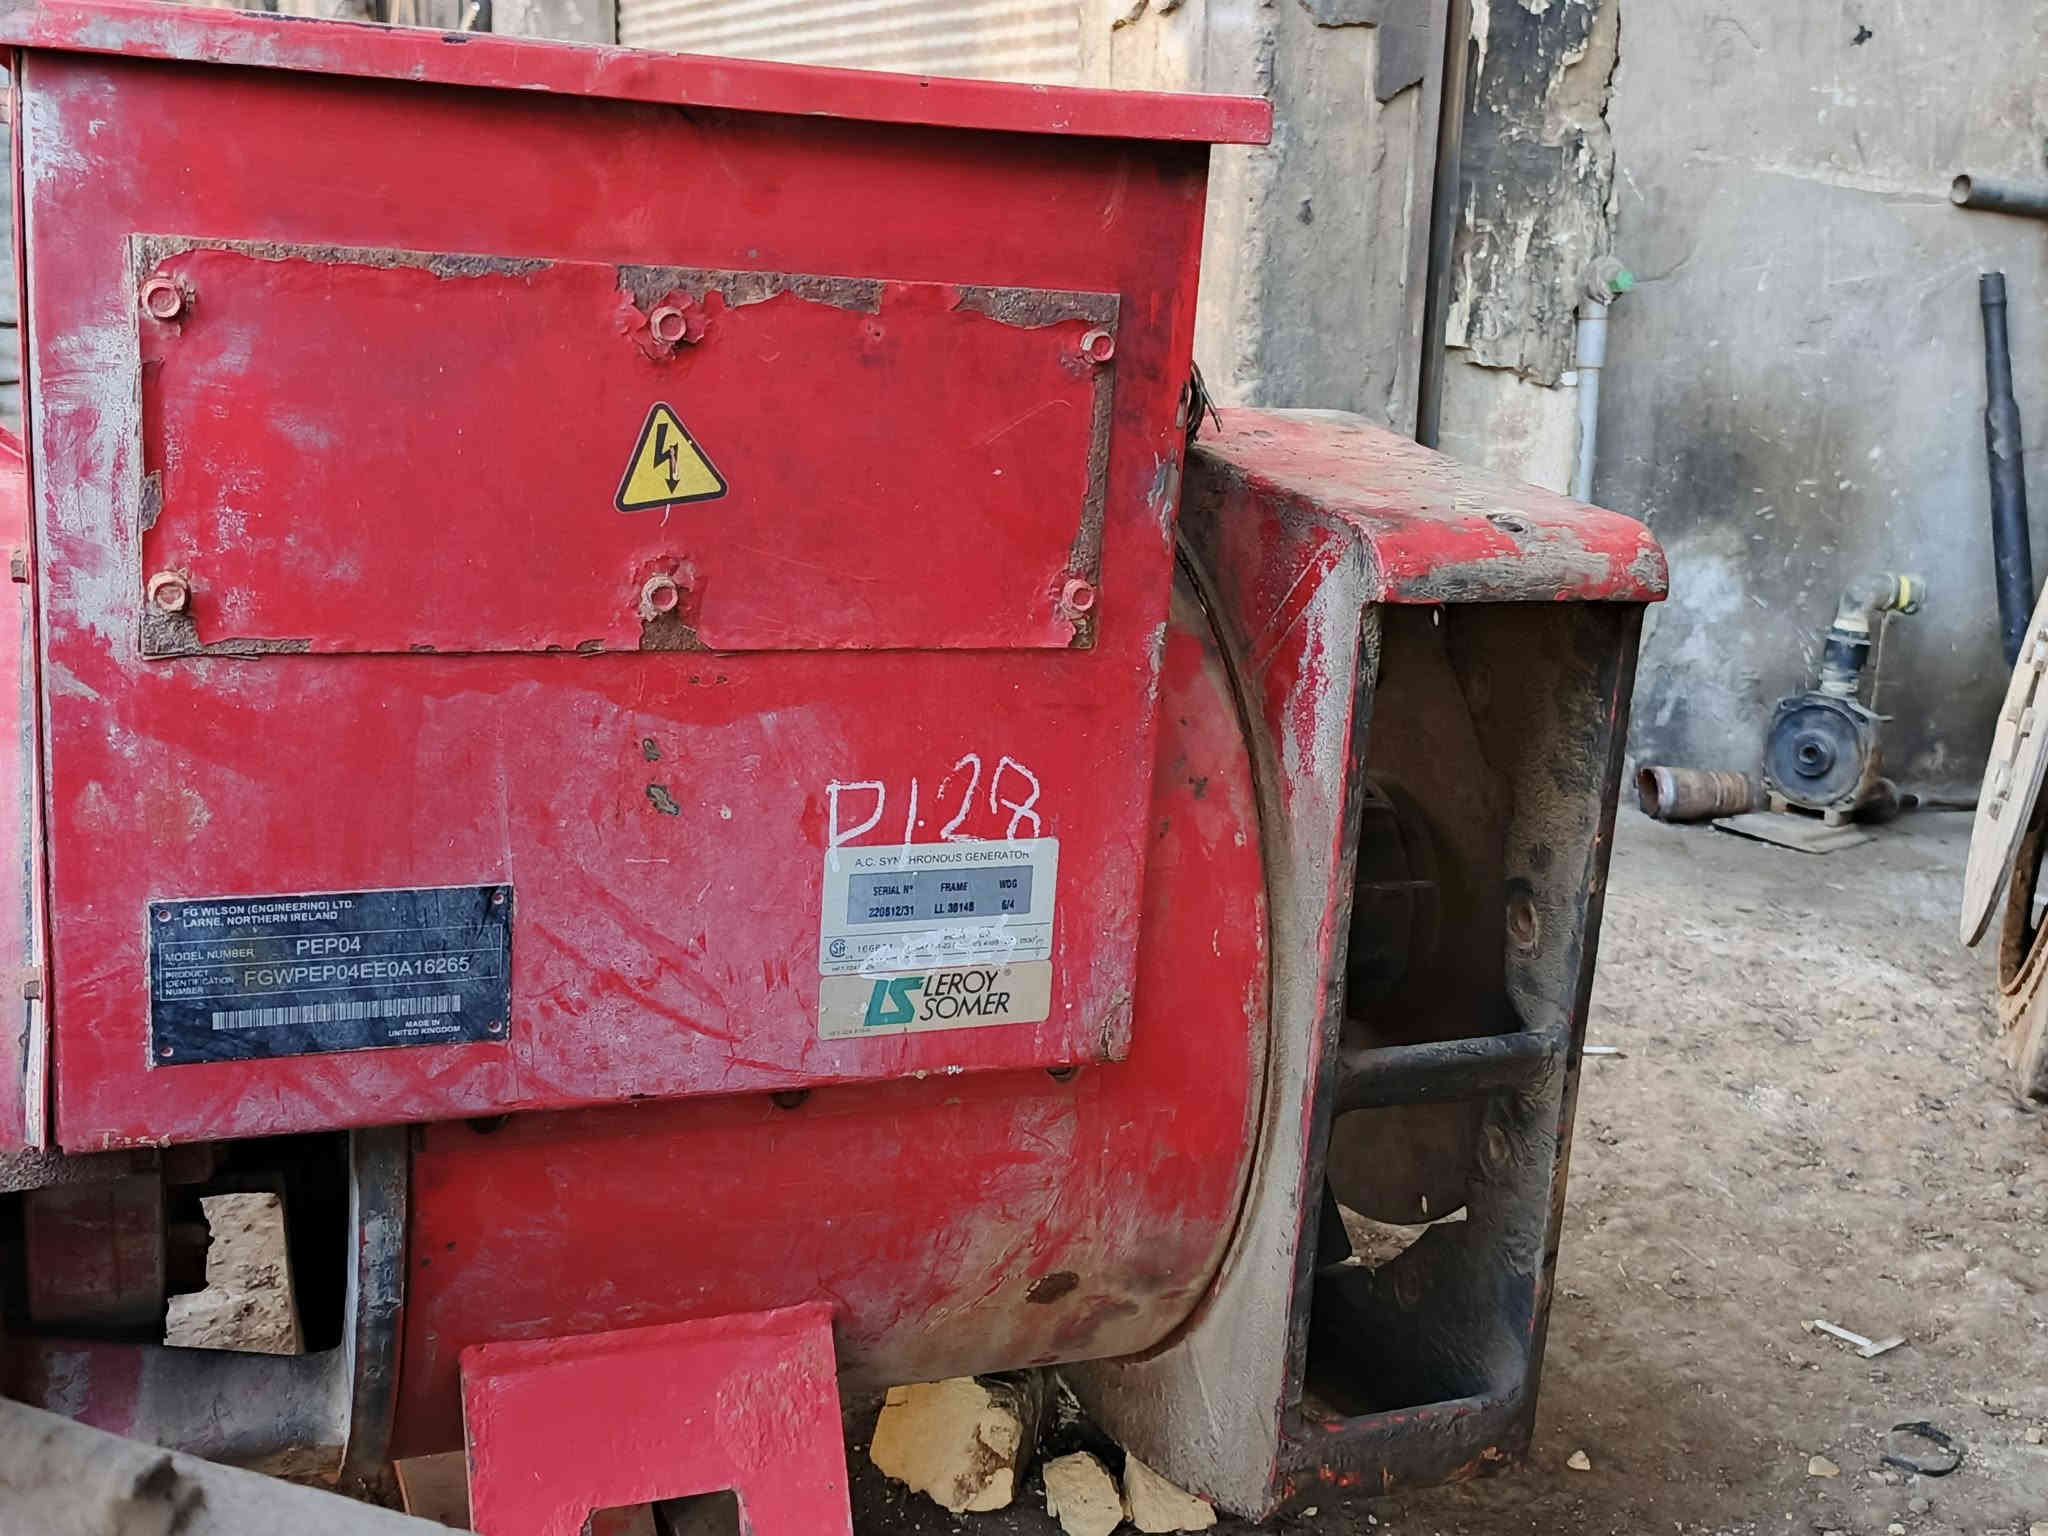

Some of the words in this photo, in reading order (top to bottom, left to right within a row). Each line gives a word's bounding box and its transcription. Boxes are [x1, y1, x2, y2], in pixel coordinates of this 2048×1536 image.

[855, 857, 877, 868] A.C.
[880, 852, 963, 867] SYNHRONOUS
[965, 849, 1030, 862] GENERATOR
[873, 885, 901, 897] SERIAL
[940, 881, 969, 893] FRAME
[999, 879, 1018, 890] WDG
[182, 908, 198, 918] FG
[201, 905, 245, 916] WILSON
[247, 902, 330, 915] (ENGINEERING)
[332, 899, 356, 910] LTD.
[226, 913, 289, 925] NORTHERN
[290, 910, 338, 922] IRELAND
[296, 936, 361, 956] PEP04
[165, 951, 205, 962] MODEL
[207, 947, 255, 960] NUMBER
[165, 969, 209, 979] PRODUCT
[244, 956, 470, 987] FGWPEP04EE0A16265
[165, 976, 234, 988] IDENTIFICATION
[922, 969, 1001, 998] LEROY
[165, 986, 204, 996] NUMBER
[919, 992, 1011, 1021] SOMER
[405, 1019, 430, 1028] MADE
[431, 1018, 440, 1027] IN
[387, 1028, 420, 1037] UNITED
[421, 1025, 461, 1035] KINGDOM
